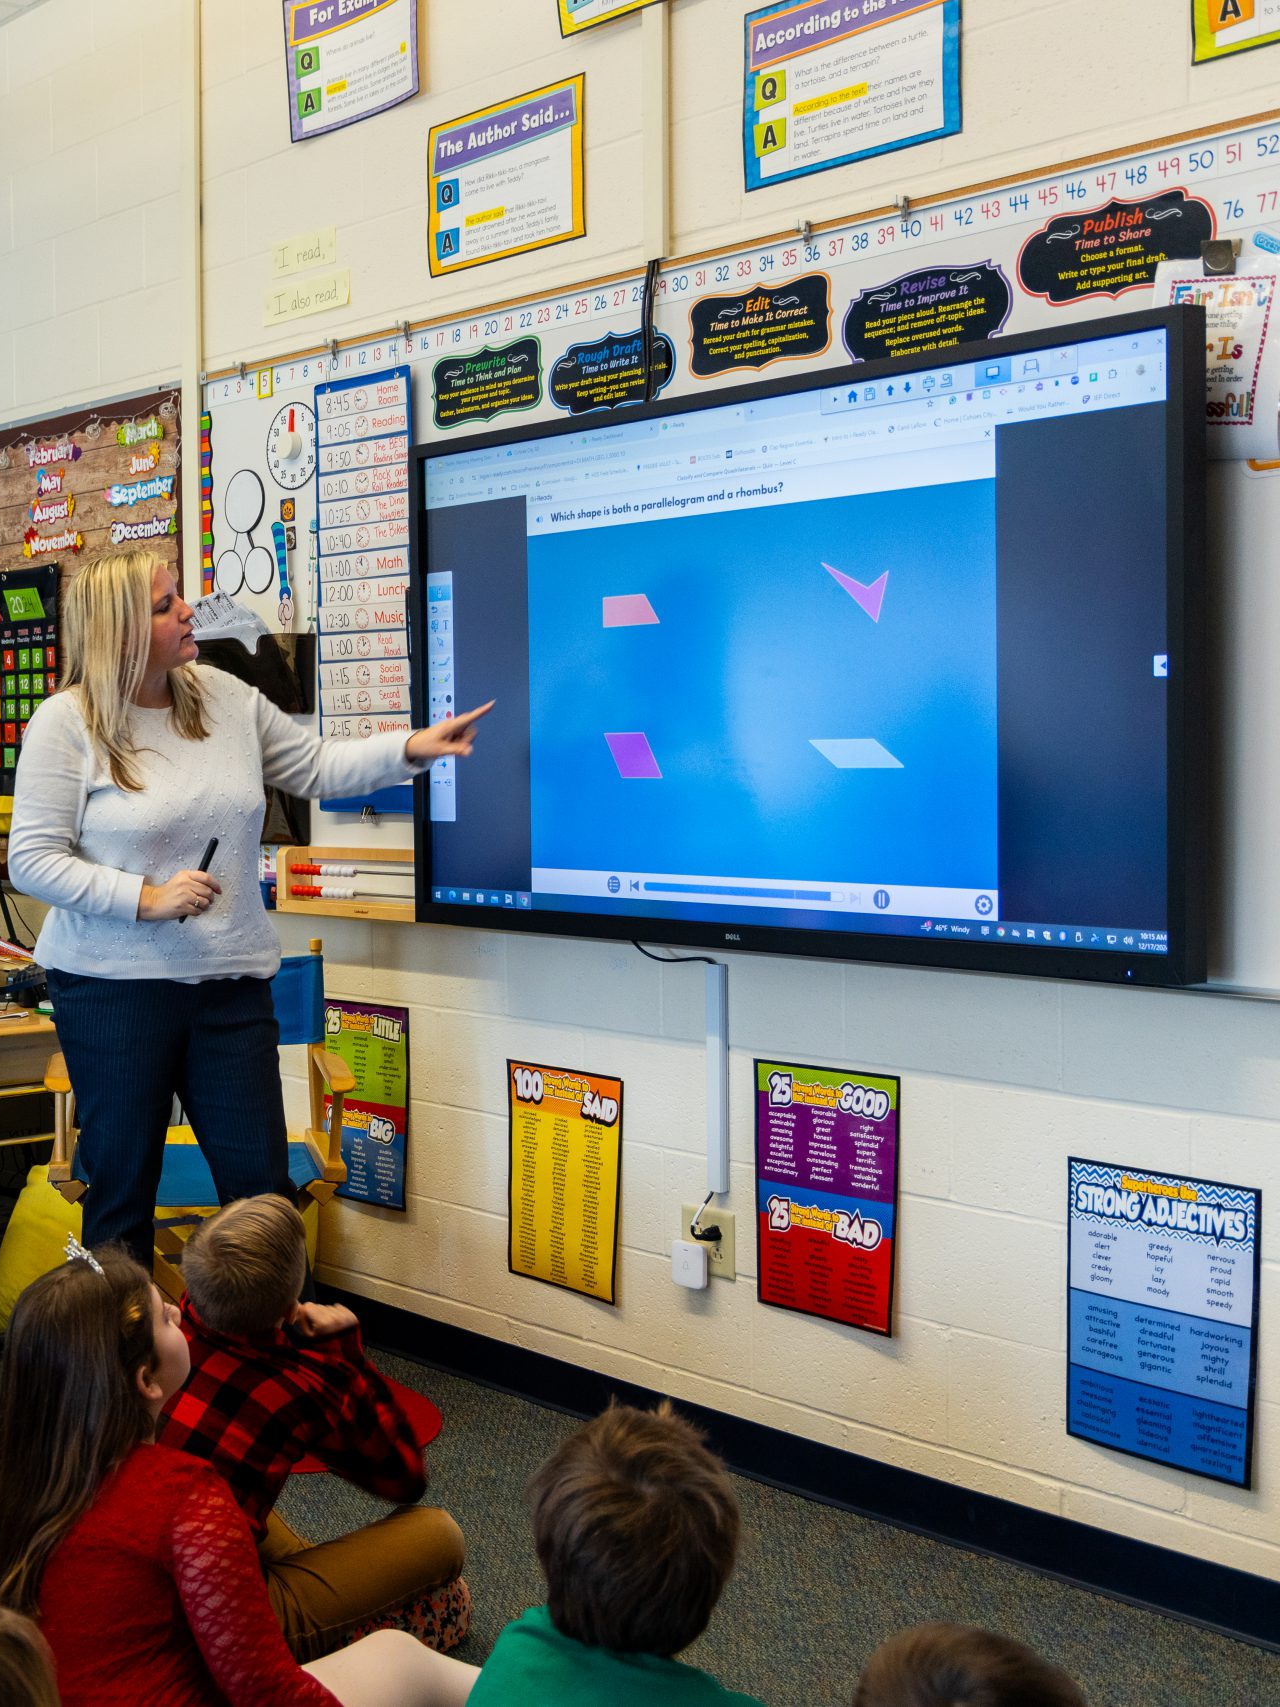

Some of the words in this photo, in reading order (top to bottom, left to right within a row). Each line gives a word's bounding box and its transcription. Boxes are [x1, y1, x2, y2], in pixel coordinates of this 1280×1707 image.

[310, 5, 334, 26] For
[755, 10, 841, 52] According
[844, 7, 859, 22] to
[862, 0, 885, 15] the
[794, 66, 812, 78] What
[820, 61, 831, 71] the
[833, 51, 867, 67] difference
[869, 39, 900, 55] between
[761, 77, 777, 101] Q
[438, 139, 464, 159] The
[468, 119, 518, 150] Author
[521, 105, 570, 132] Said...
[762, 125, 778, 149] A
[1066, 180, 1087, 200] 46
[1125, 166, 1148, 186] 48
[1188, 150, 1214, 172] 50
[1223, 200, 1244, 219] 76
[1083, 208, 1143, 235] Publish
[279, 247, 288, 269] I
[782, 249, 797, 267] 35
[851, 233, 869, 251] 38
[1080, 250, 1107, 263] Choose
[1109, 248, 1114, 257] a
[1116, 244, 1145, 258] format.
[900, 275, 946, 297] Revise
[1174, 285, 1214, 305] Fair
[1217, 282, 1268, 307] Isn't
[745, 297, 770, 313] Edit
[880, 300, 902, 313] Time
[904, 298, 914, 308] to
[917, 288, 957, 306] Improve
[959, 285, 968, 296] It
[578, 349, 609, 364] Rough
[613, 341, 642, 358] Draft
[465, 356, 506, 373] Prewrite
[326, 393, 350, 413] 8:45
[124, 420, 159, 443] March
[372, 414, 406, 428] Reading
[28, 444, 74, 467] February
[129, 455, 154, 475] June
[41, 474, 61, 493] May
[110, 476, 174, 506] September
[32, 501, 68, 524] August
[550, 512, 576, 523] Which
[577, 509, 602, 521] shape
[604, 506, 610, 516] is
[612, 503, 632, 515] both
[641, 495, 705, 513] parallelogram
[707, 490, 725, 502] and
[727, 491, 733, 499] a
[736, 482, 784, 498] rhombus?
[325, 506, 352, 525] 10:25
[30, 531, 78, 554] November
[111, 519, 171, 544] December
[325, 559, 351, 577] 11:00
[377, 556, 403, 570] Math
[325, 585, 354, 602] 12:00
[378, 583, 406, 597] Lunch
[9, 596, 34, 614] 2024
[325, 613, 350, 628] 12:30
[374, 611, 404, 626] Music
[379, 674, 405, 683] Studies
[380, 664, 402, 673] Social
[1140, 932, 1154, 941] 10:15
[326, 1009, 341, 1034] 25
[373, 1015, 401, 1042] LITTLE
[514, 1068, 543, 1100] 100
[770, 1074, 791, 1104] 25
[582, 1092, 617, 1124] SAID
[839, 1083, 889, 1119] GOOD
[768, 1110, 796, 1120] acceptable
[369, 1118, 394, 1144] BIG
[769, 1142, 794, 1152] delightful
[1121, 1176, 1180, 1198] Superheroes
[769, 1198, 789, 1229] 25
[1076, 1183, 1141, 1221] STRONG
[1143, 1199, 1248, 1242] ADJECTIVES
[837, 1211, 880, 1248] BAD
[1088, 1231, 1118, 1242] adorable
[1134, 1315, 1181, 1332] determined
[1190, 1327, 1243, 1347] hardworking
